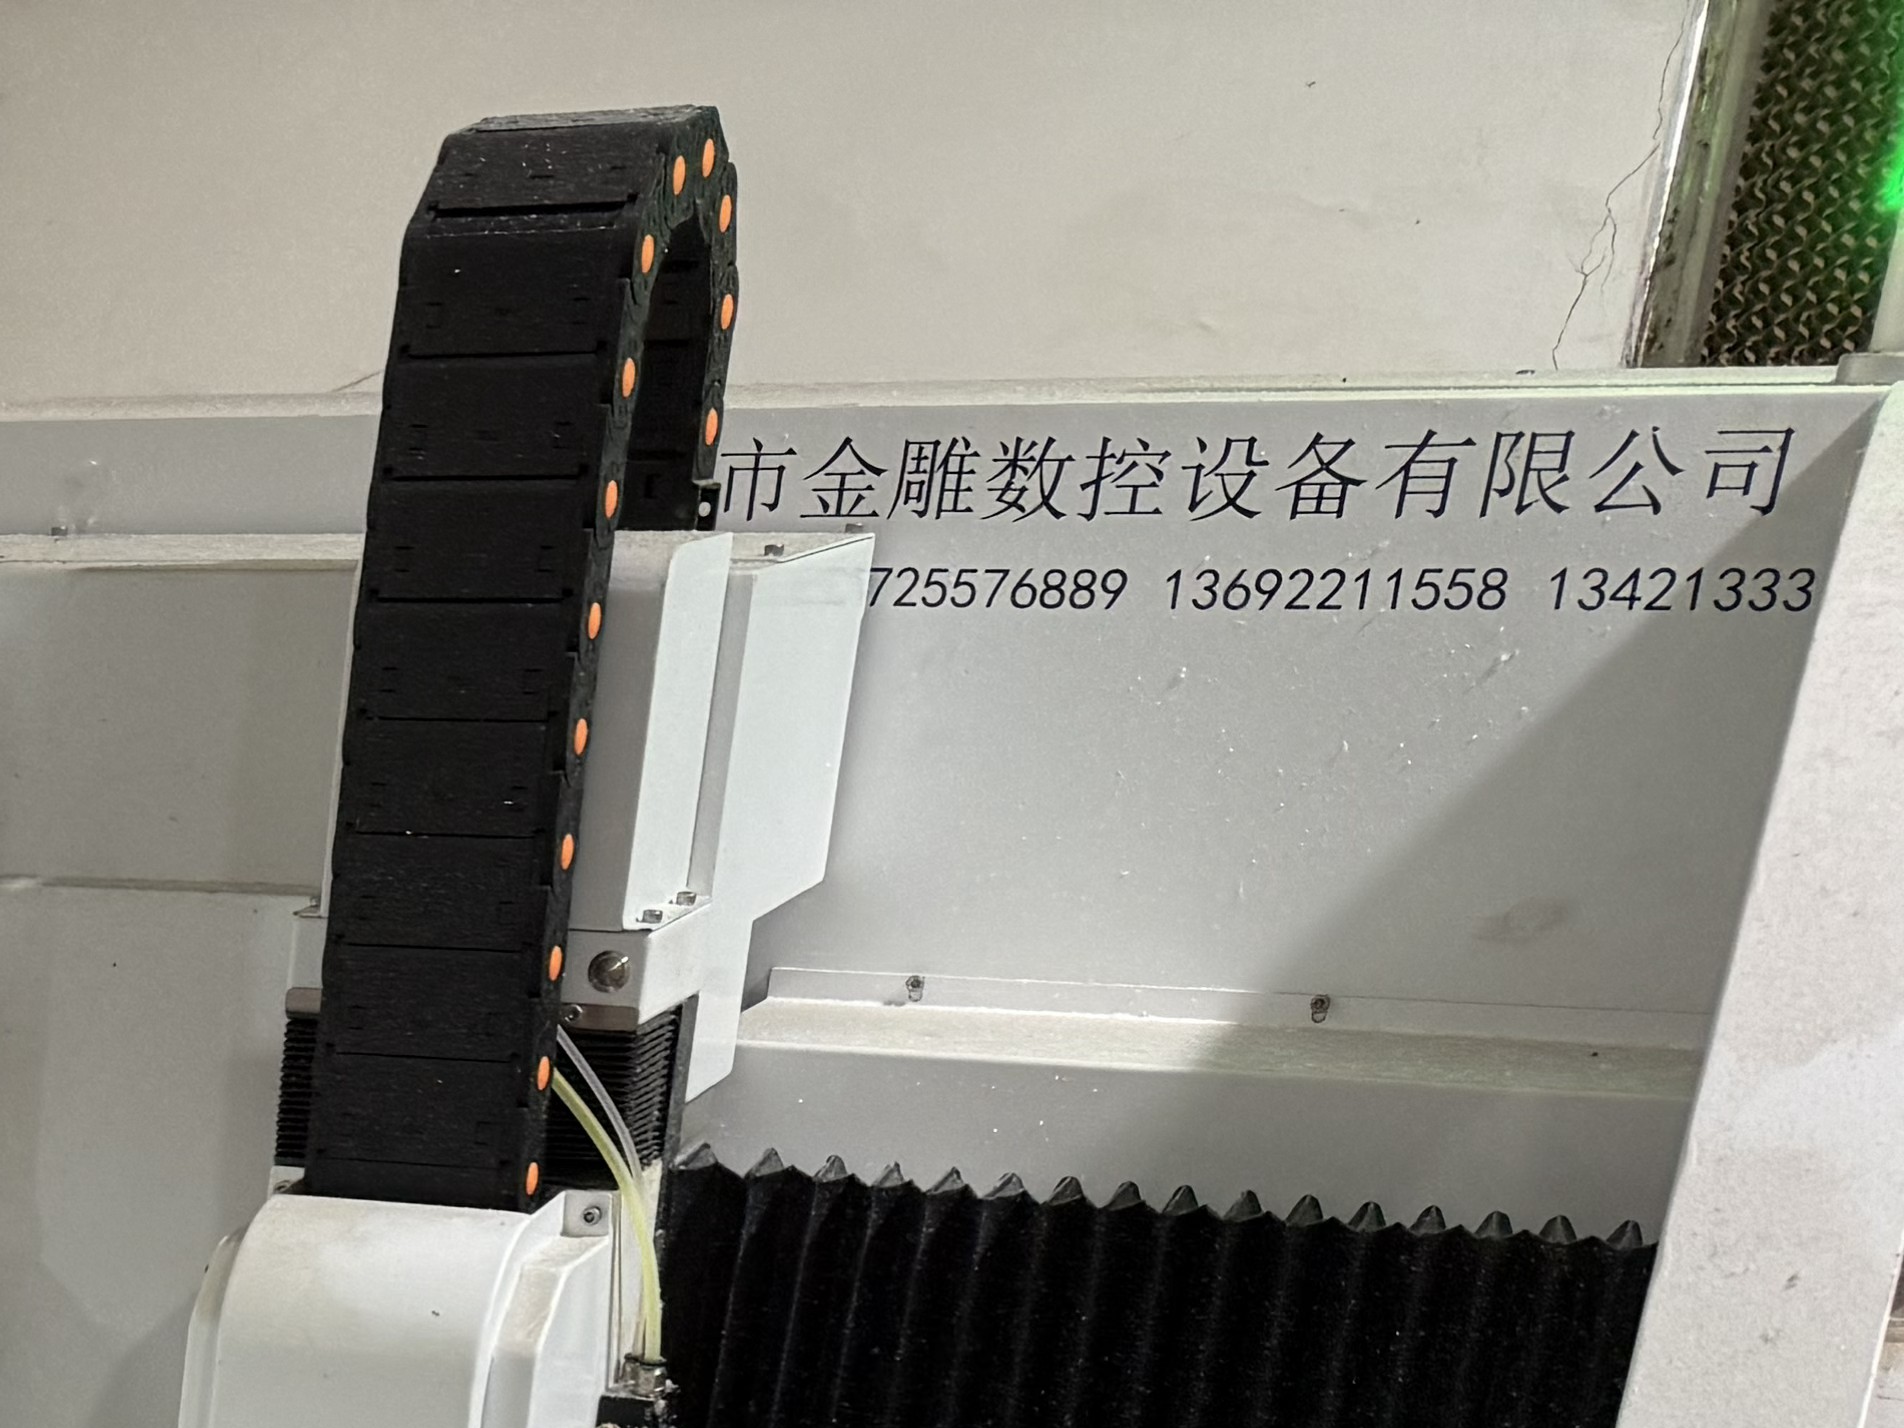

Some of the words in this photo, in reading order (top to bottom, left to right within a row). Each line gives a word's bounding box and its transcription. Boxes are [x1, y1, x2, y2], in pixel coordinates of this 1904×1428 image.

[721, 426, 1796, 522] 市金雕数控设备有限公司
[870, 566, 1129, 613] 725576889
[1162, 566, 1508, 613] 13692211558
[1550, 566, 1817, 612] 13421333
